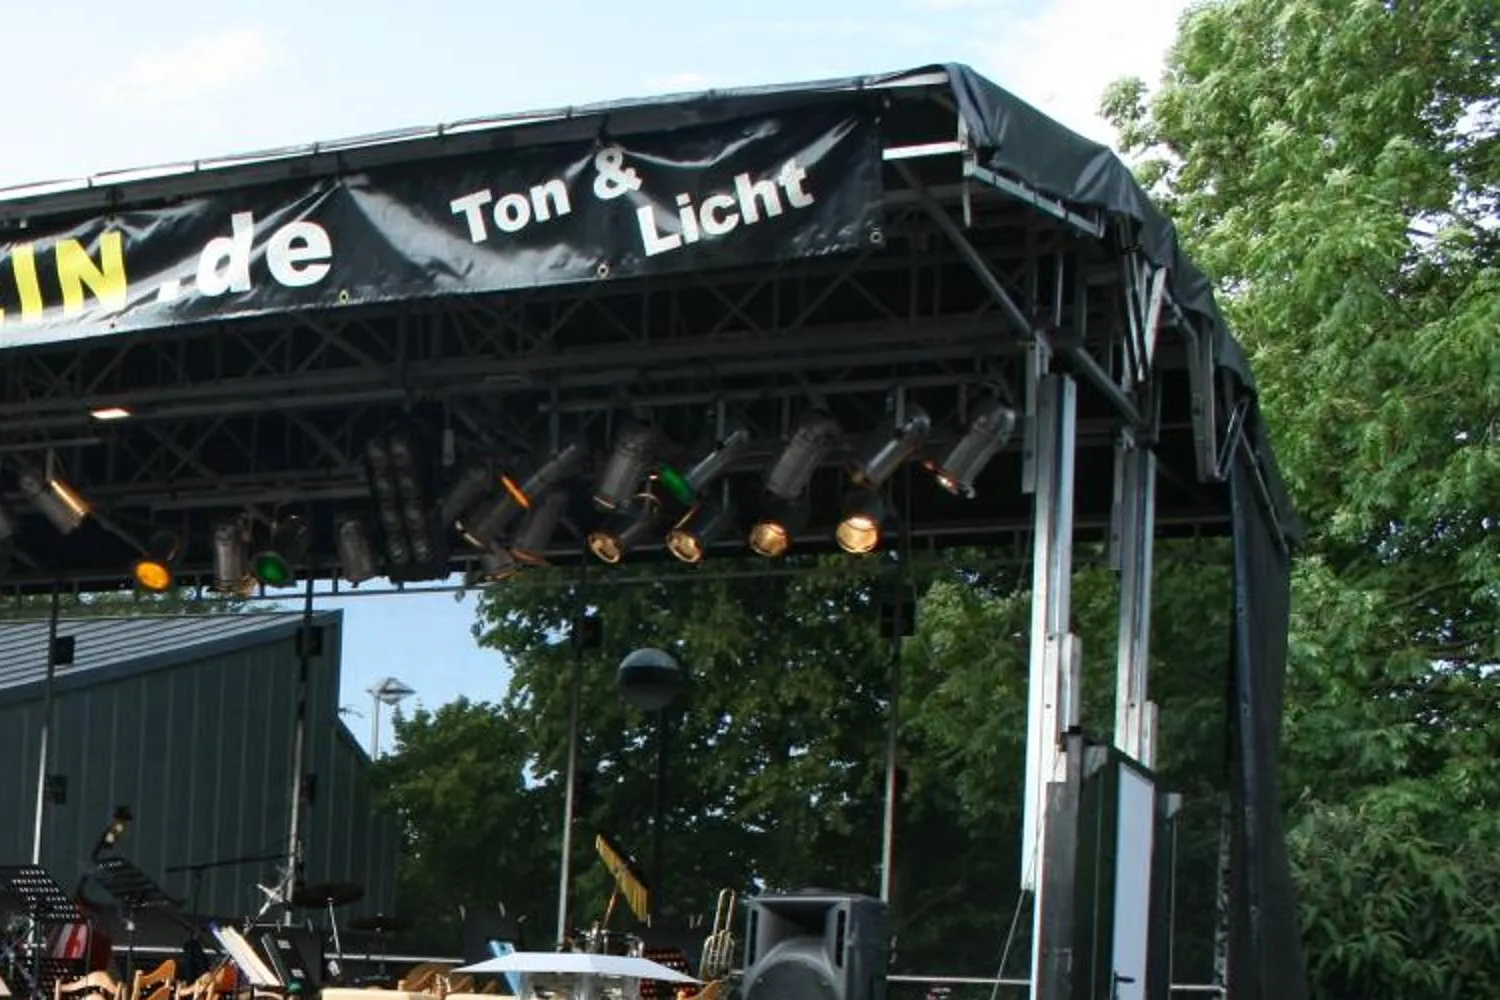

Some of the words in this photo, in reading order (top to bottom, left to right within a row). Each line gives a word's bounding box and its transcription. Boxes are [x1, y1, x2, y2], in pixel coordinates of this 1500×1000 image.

[451, 178, 572, 243] Ton
[593, 146, 642, 199] &
[637, 166, 815, 257] Licht
